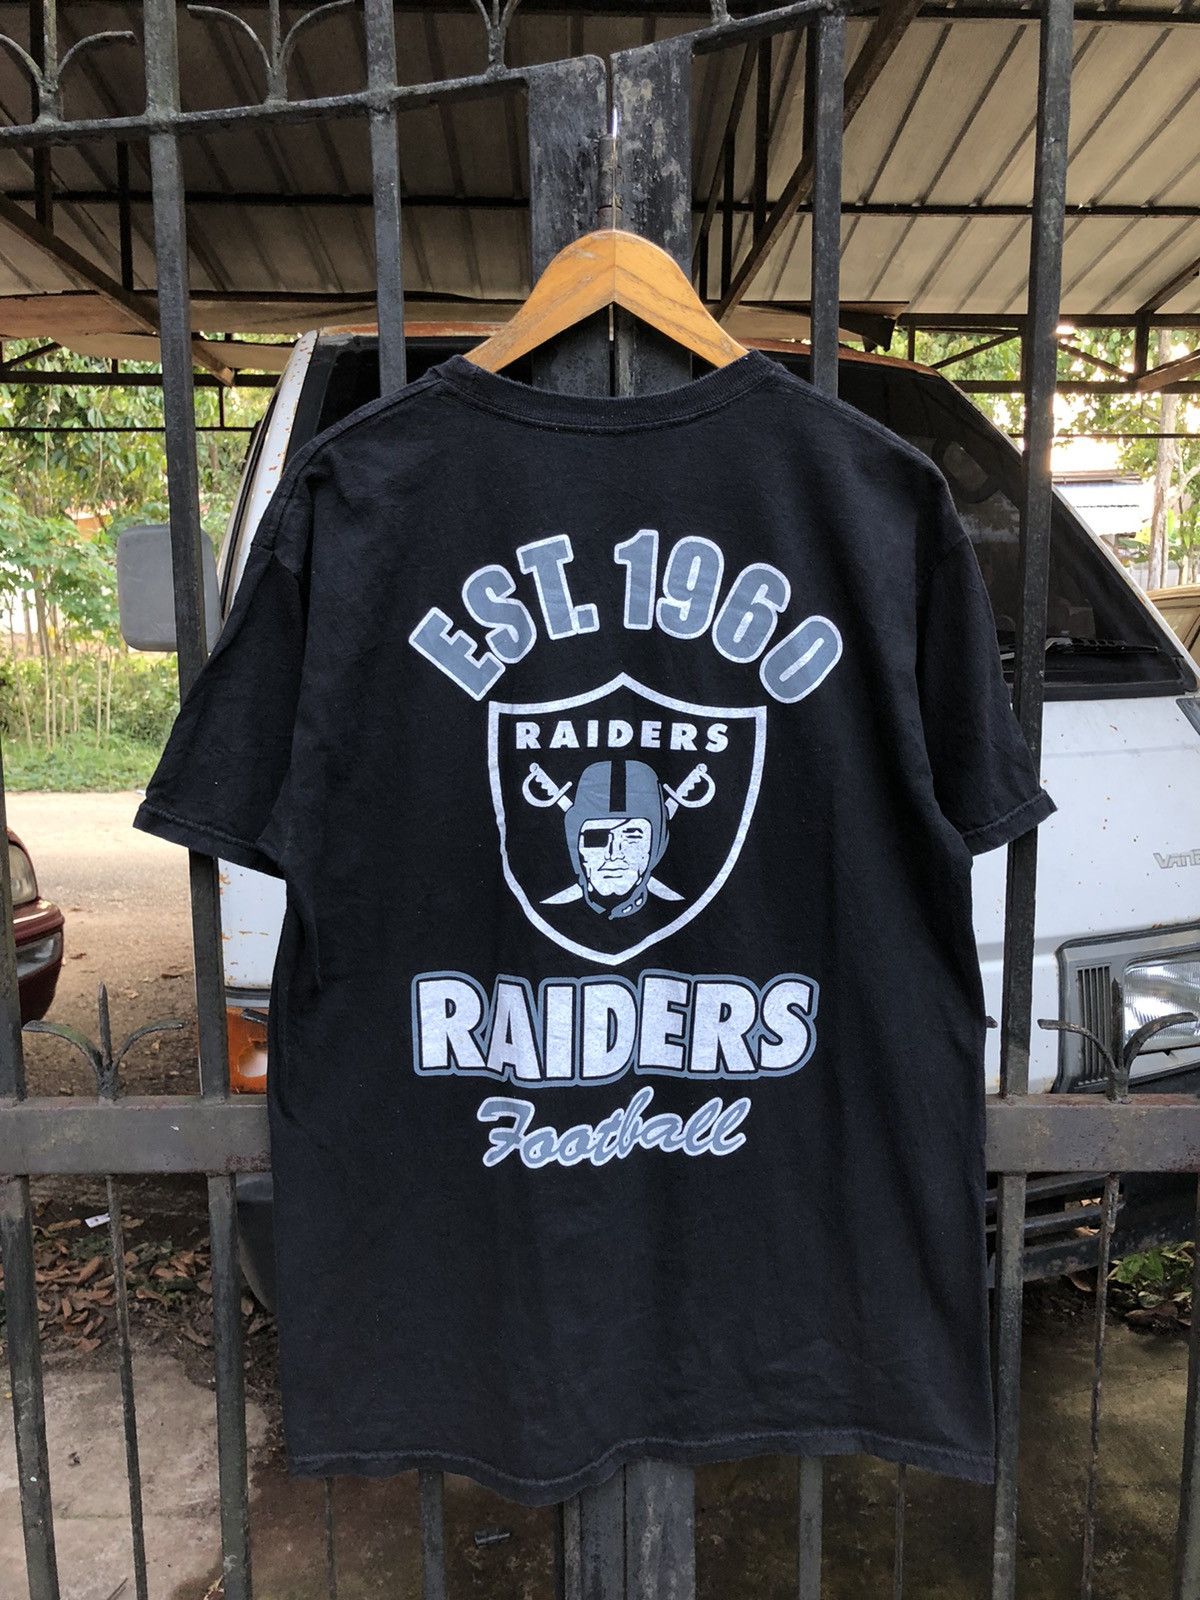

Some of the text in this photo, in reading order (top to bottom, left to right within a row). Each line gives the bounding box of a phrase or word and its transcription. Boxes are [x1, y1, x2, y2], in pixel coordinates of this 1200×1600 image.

[409, 529, 843, 704] EST. 1960
[515, 719, 729, 753] RAIDERS
[411, 968, 820, 1088] RAIDERS
[477, 1086, 751, 1169] Football
